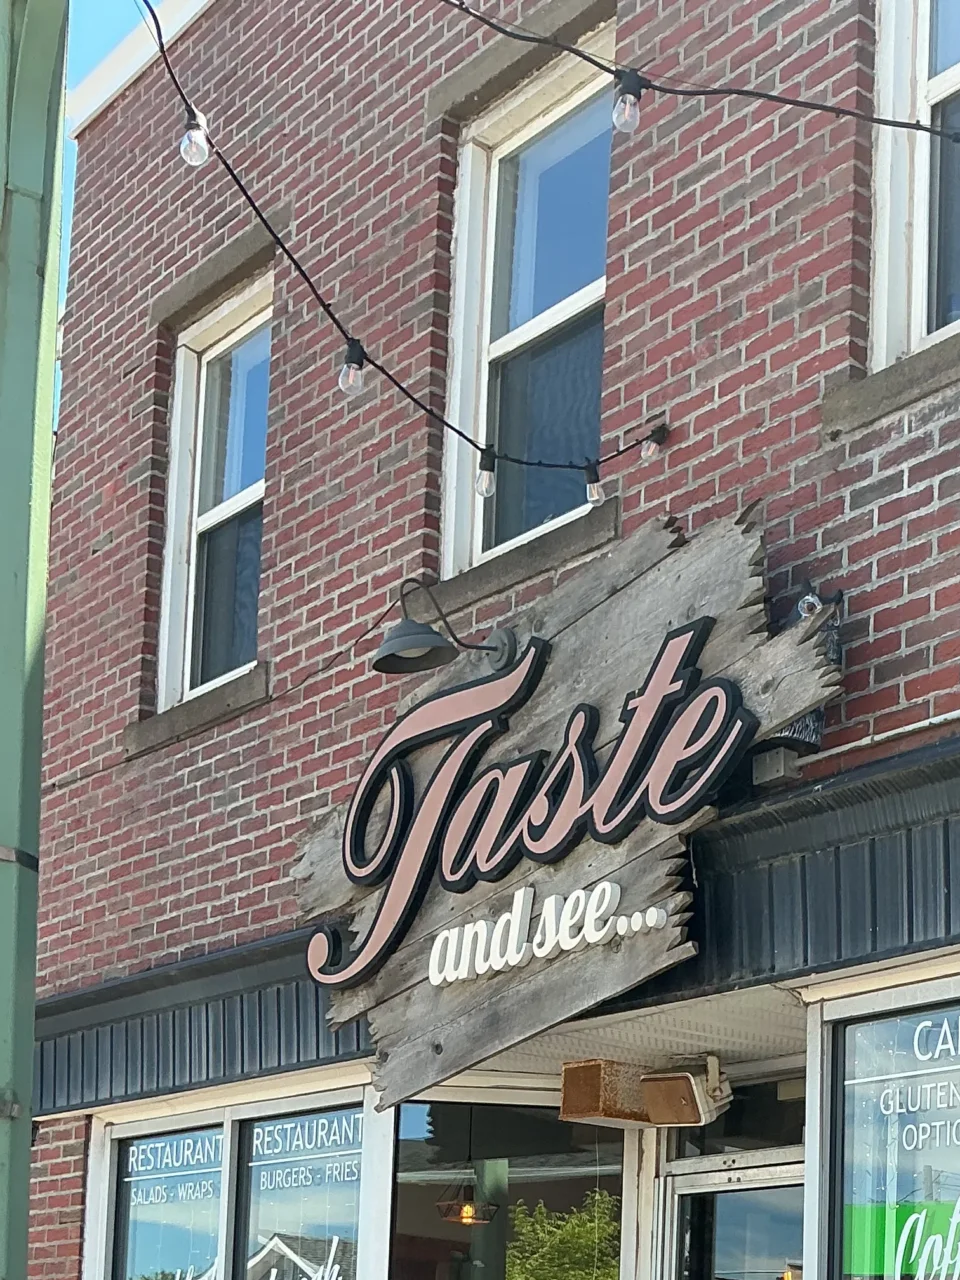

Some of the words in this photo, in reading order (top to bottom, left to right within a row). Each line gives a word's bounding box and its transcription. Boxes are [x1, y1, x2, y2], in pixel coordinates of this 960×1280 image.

[306, 615, 760, 988] Taste
[428, 885, 536, 986] and
[532, 880, 668, 959] see...
[128, 1134, 224, 1173] RESTAURANT
[252, 1113, 364, 1156] RESTAURANT
[130, 1184, 167, 1206] SALADS
[177, 1179, 214, 1200] WRAPS
[260, 1165, 313, 1190] BURGERS
[325, 1160, 359, 1183] FRIES
